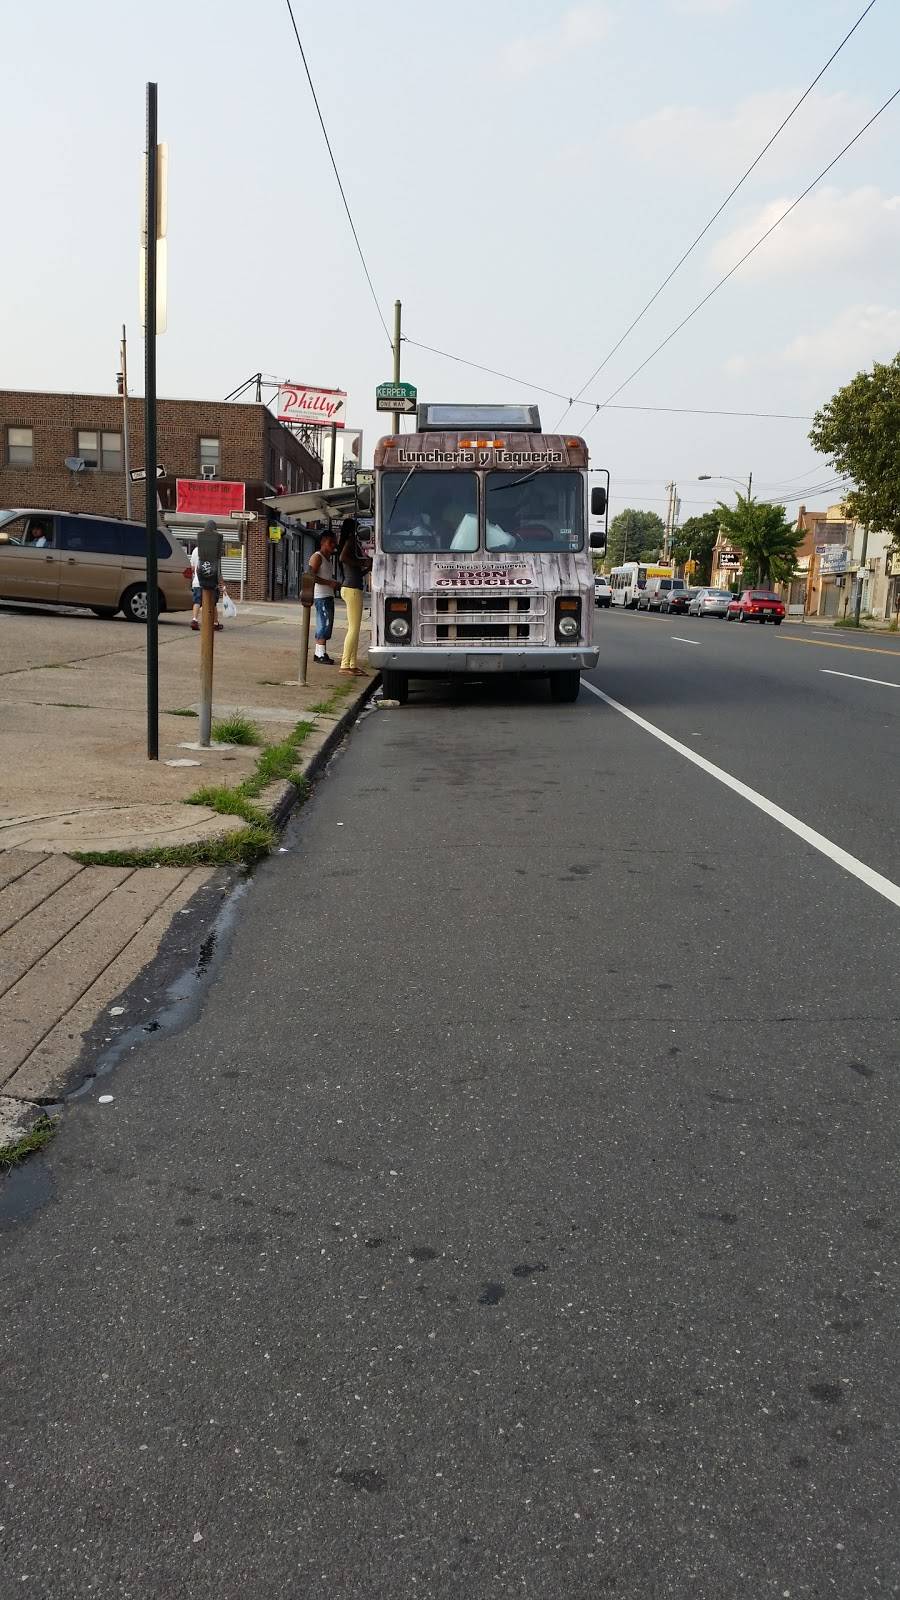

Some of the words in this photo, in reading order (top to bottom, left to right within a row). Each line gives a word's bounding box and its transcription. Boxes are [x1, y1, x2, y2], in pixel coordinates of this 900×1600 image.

[377, 388, 406, 397] KERPER
[398, 449, 474, 463] Luncheria
[479, 452, 490, 466] y
[495, 449, 562, 465] Taqueria
[436, 578, 532, 587] CHUCHO
